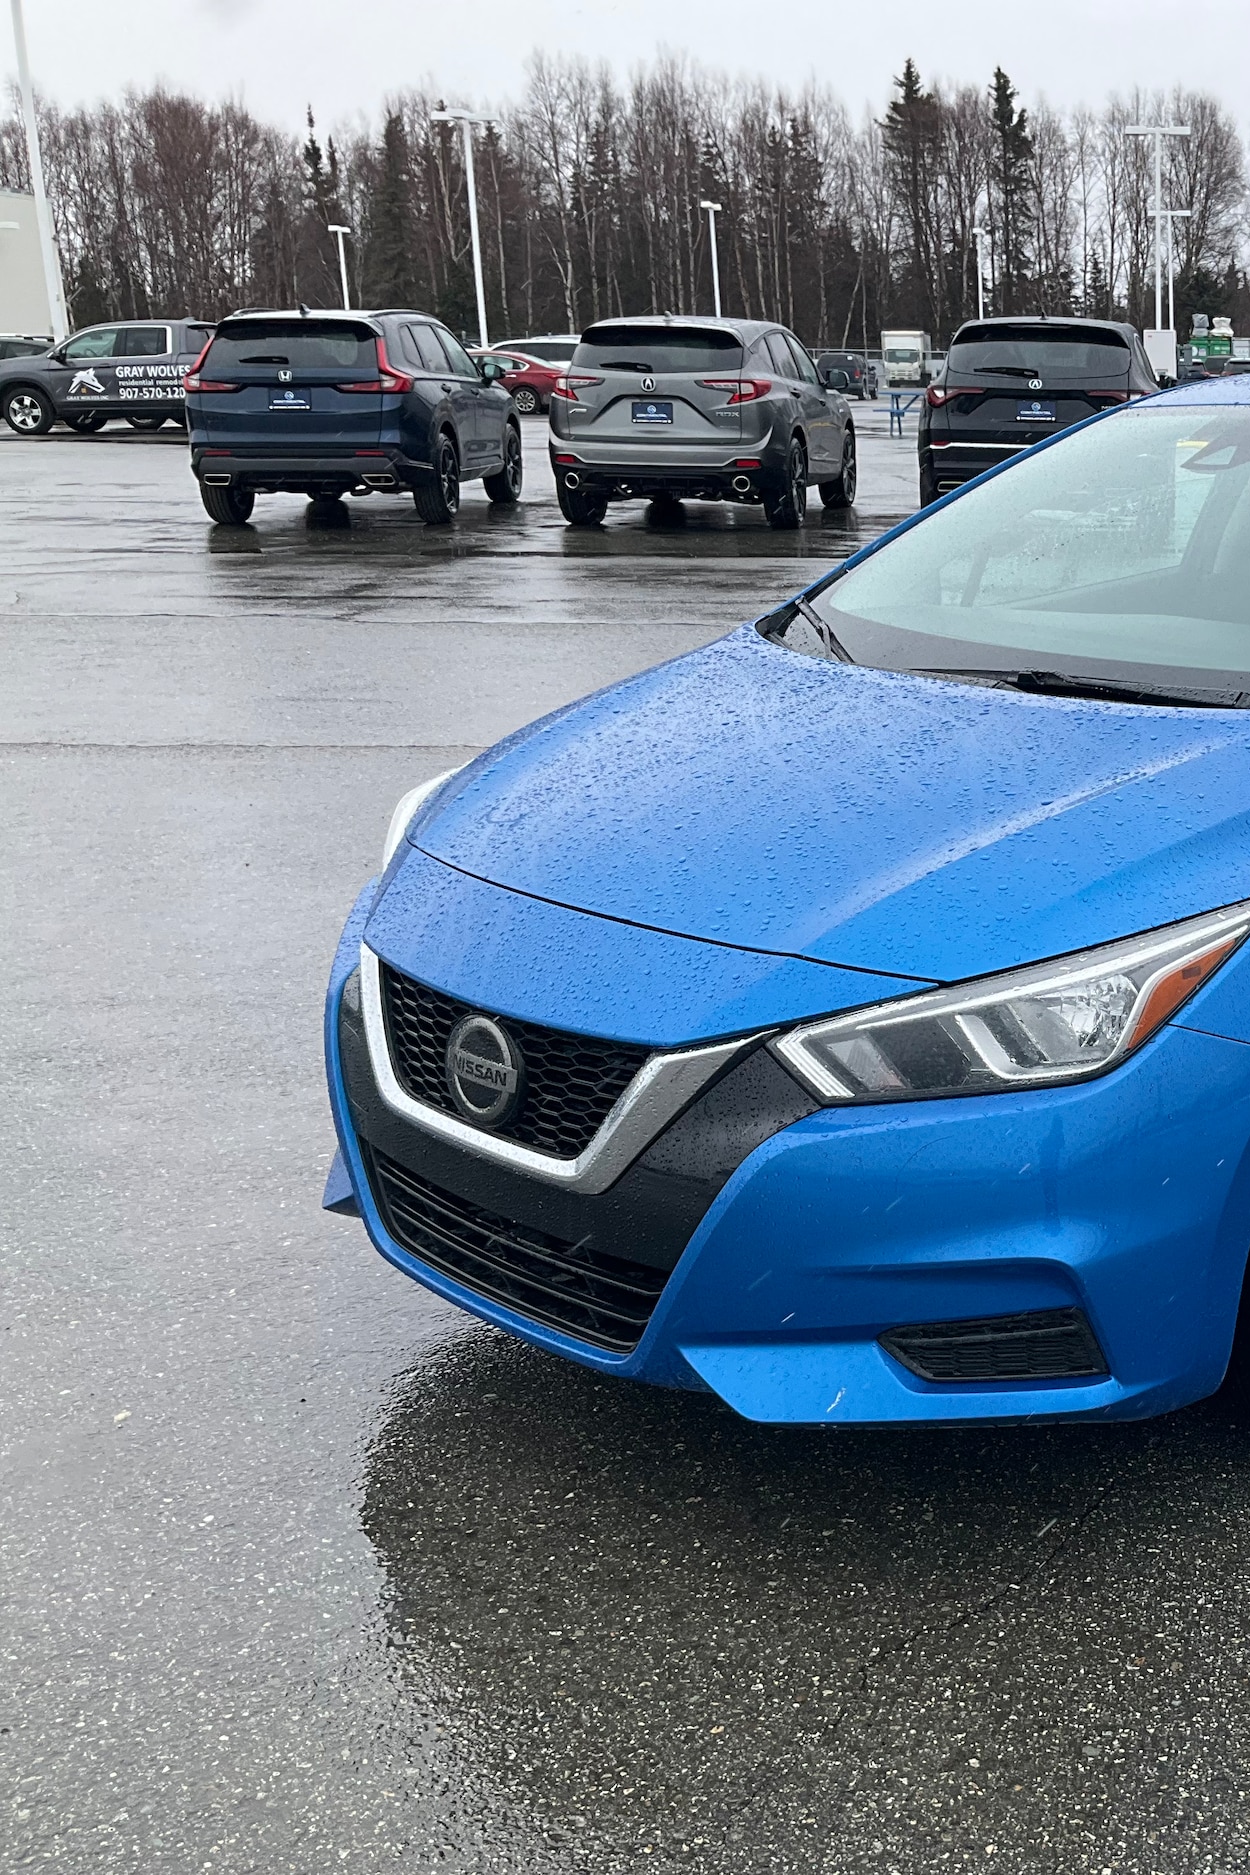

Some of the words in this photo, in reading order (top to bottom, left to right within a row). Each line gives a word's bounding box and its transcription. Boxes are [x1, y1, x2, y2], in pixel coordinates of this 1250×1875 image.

[115, 366, 145, 378] GRAY
[146, 365, 191, 377] WOLVES
[119, 387, 186, 399] 907-570-120
[453, 1054, 507, 1087] NISSAN
